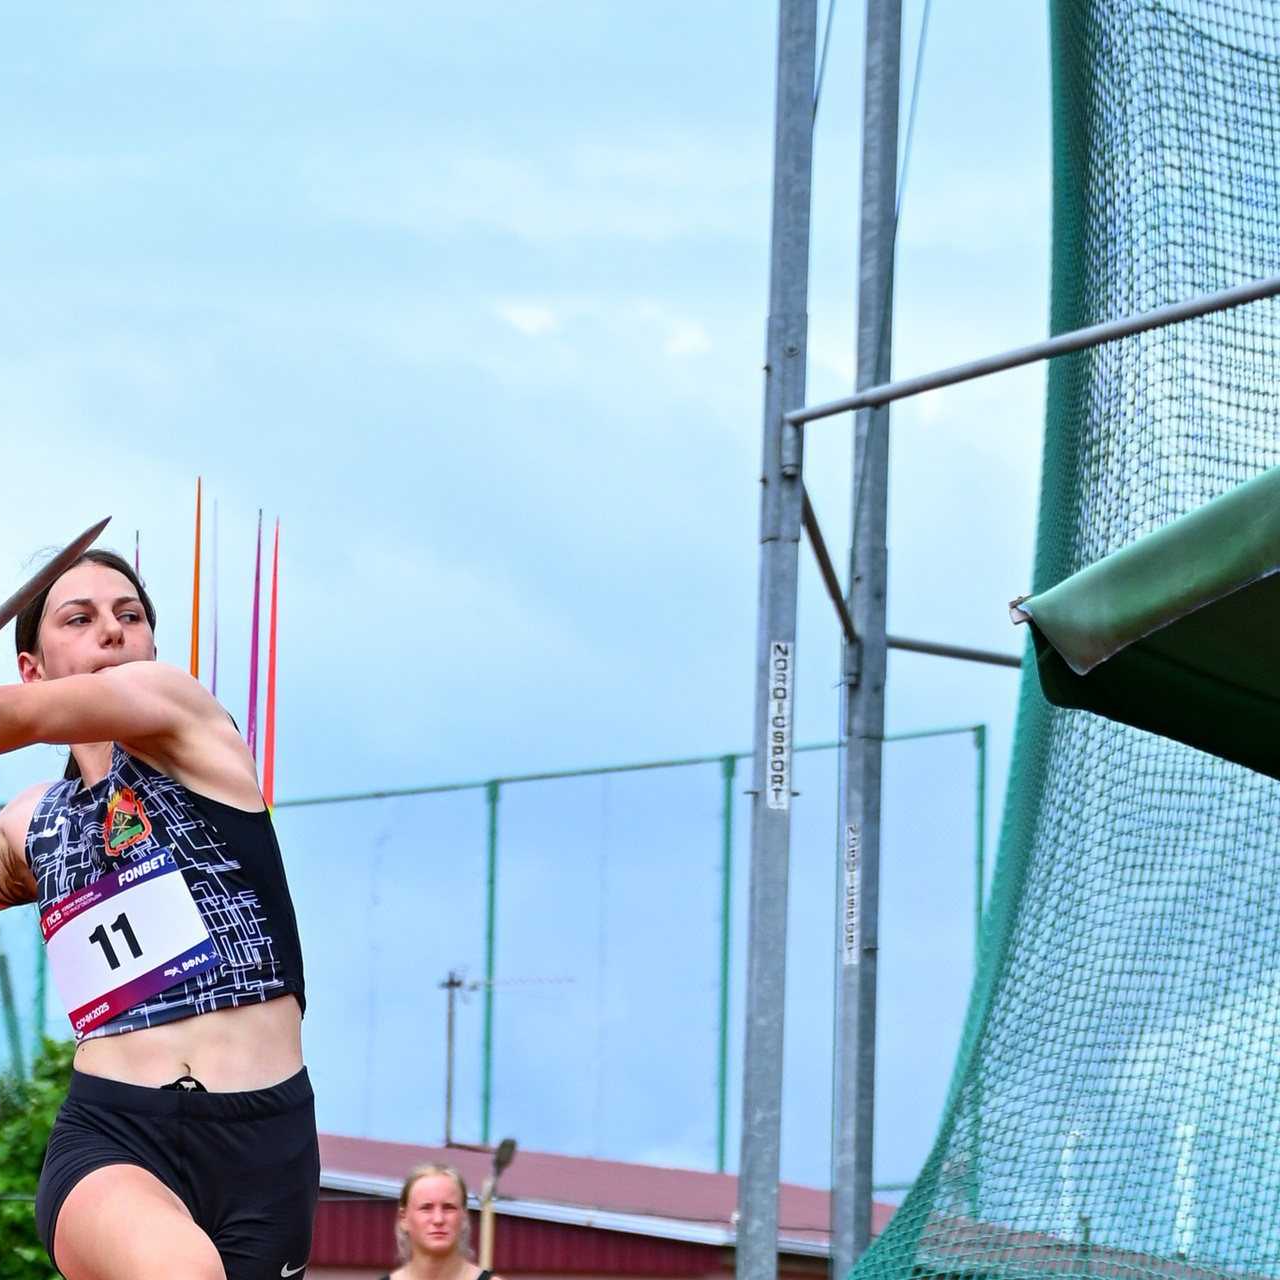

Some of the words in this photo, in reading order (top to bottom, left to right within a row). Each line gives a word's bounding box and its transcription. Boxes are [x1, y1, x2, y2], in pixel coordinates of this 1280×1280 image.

[118, 853, 167, 887] FONBET
[88, 912, 144, 971] 11
[182, 953, 209, 972] ВФЛА
